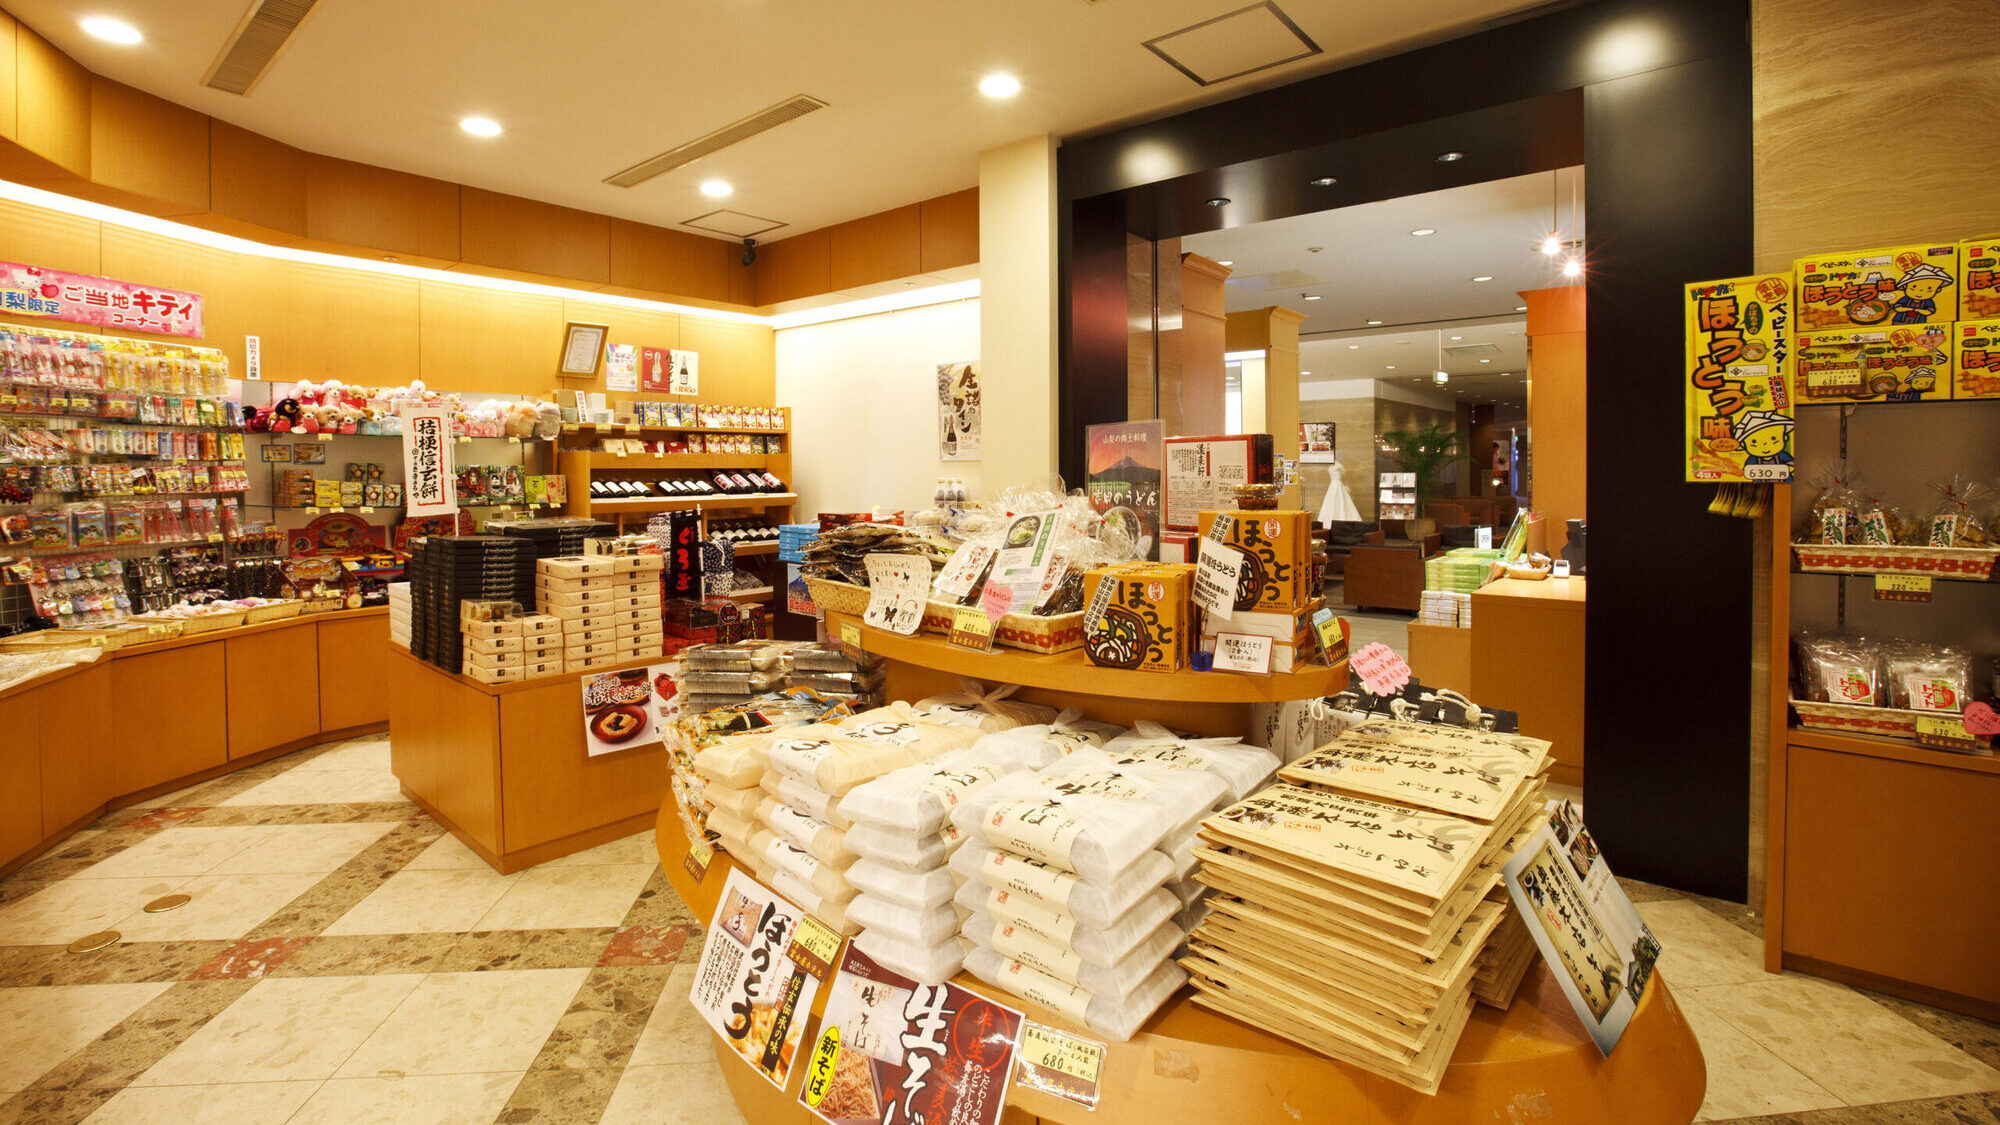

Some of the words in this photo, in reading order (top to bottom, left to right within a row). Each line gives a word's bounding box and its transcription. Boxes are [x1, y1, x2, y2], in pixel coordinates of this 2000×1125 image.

[0, 291, 60, 314] 梨限定
[64, 284, 193, 320] ご当地キティ
[1691, 282, 1735, 301] ドデカイ
[1803, 278, 1897, 306] ほうとう味
[113, 313, 161, 327] コーナー
[1769, 302, 1788, 374] ベビースター
[1815, 335, 1847, 343] ベビースター
[1691, 295, 1747, 440] ほうとう味
[1867, 355, 1933, 370] ほうとう味
[1103, 432, 1148, 443] 山梨の郷土料理
[418, 420, 439, 499] 桔梗信玄餅
[1750, 469, 1773, 477] 630
[1093, 490, 1157, 506] 吉田のうどん
[1233, 518, 1291, 601] ほうとう
[1118, 580, 1173, 663] ほうとう
[1225, 639, 1262, 649] 開運ほうとう
[1388, 829, 1455, 854] そば
[1334, 842, 1434, 879] そばつゆ付
[805, 938, 817, 951] 680
[723, 901, 791, 1040] ほうとう
[790, 949, 822, 977] 富士屋ホテル
[769, 976, 801, 1055] 信玄伝承の味
[855, 985, 880, 1049] 生そば
[810, 1035, 838, 1097] 新そば
[1043, 1053, 1063, 1070] 680
